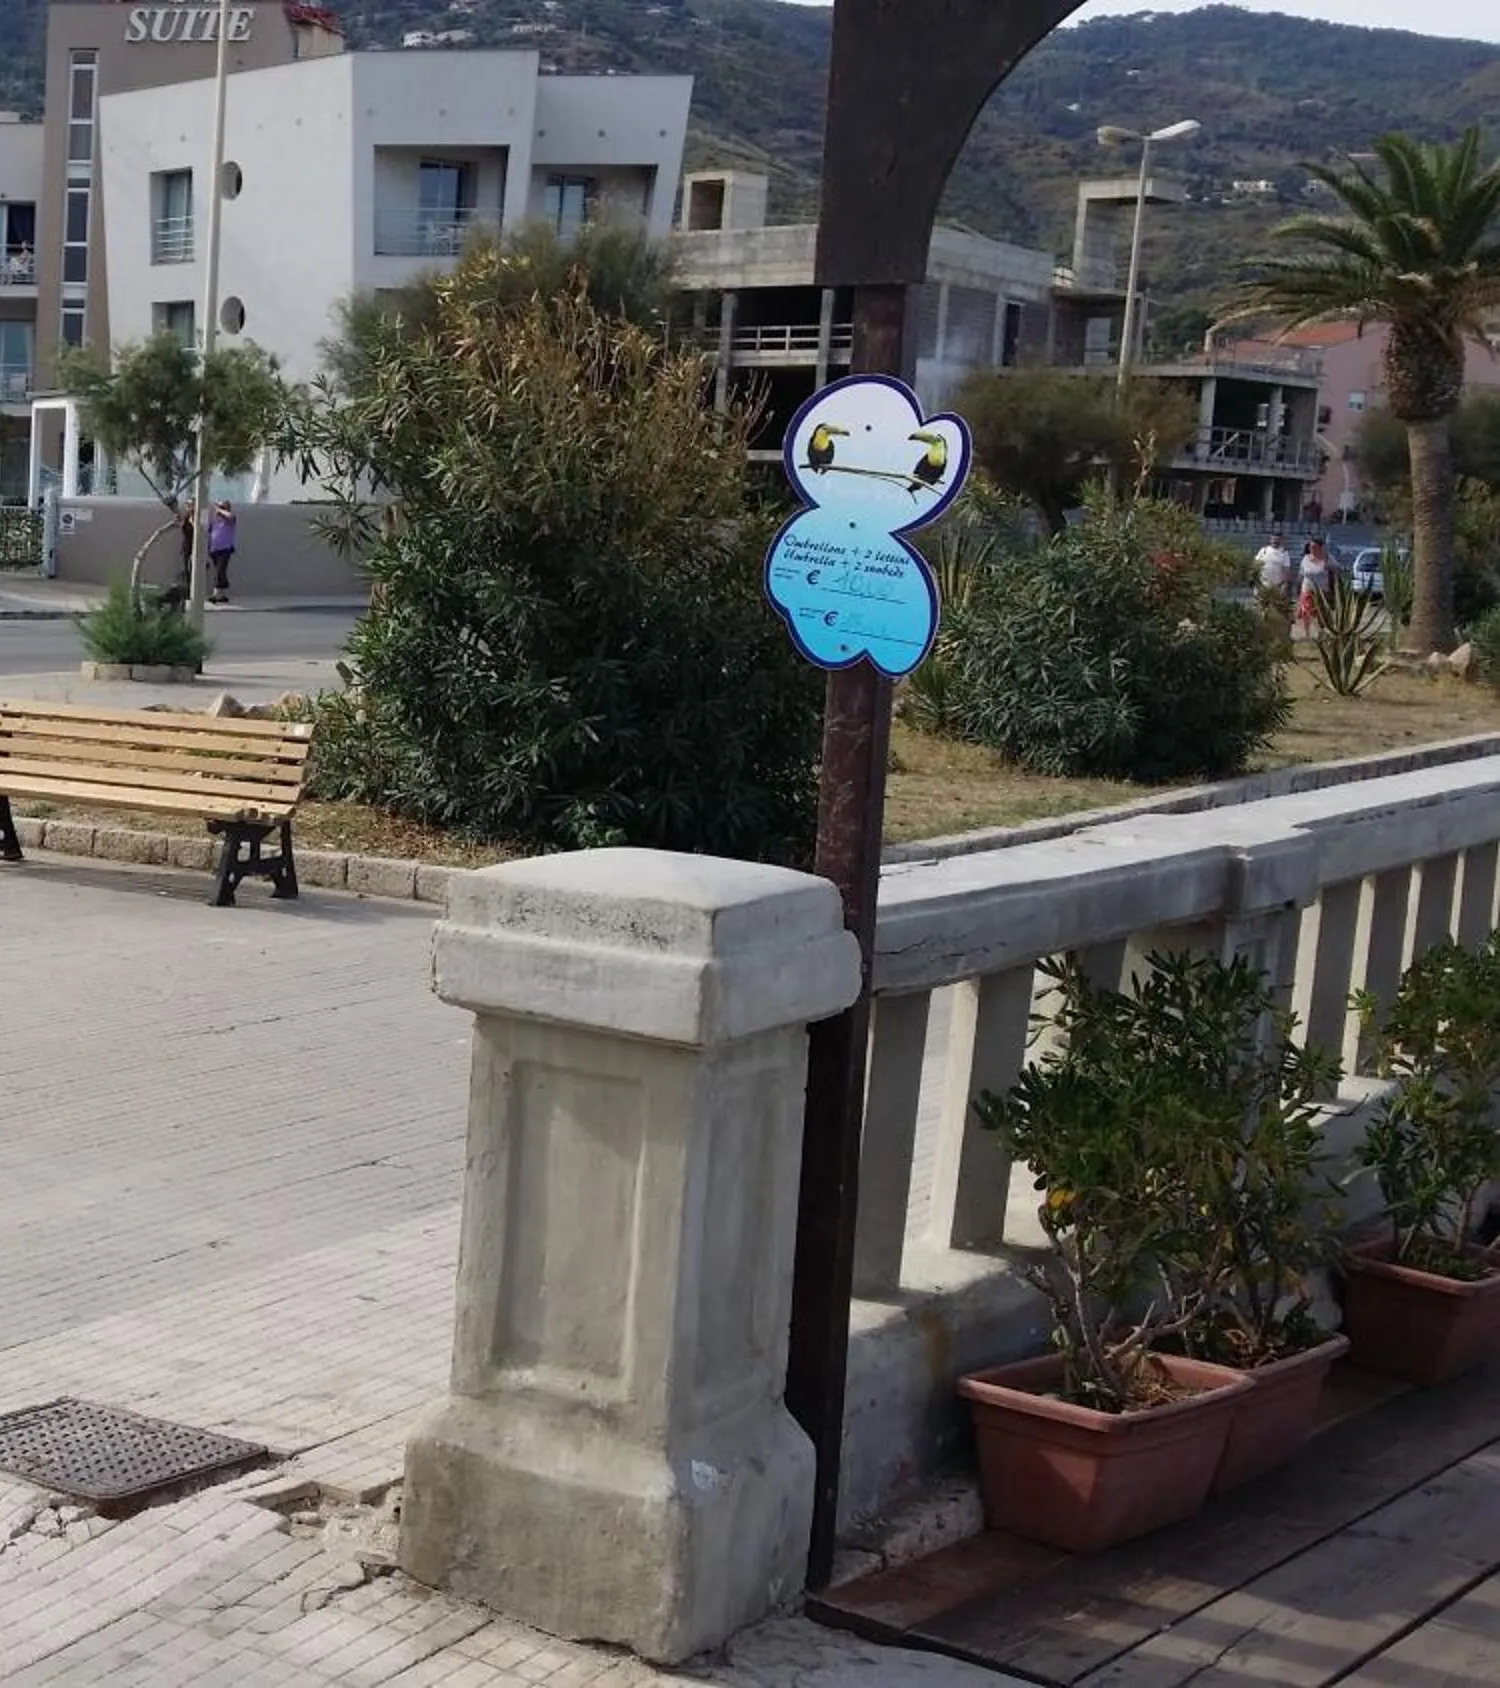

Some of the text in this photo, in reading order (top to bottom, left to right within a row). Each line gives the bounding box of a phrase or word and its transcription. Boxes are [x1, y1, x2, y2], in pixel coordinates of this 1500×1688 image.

[124, 7, 255, 42] SUITE
[783, 547, 837, 567] Umbrella
[806, 569, 821, 585] €
[823, 611, 839, 626] €
